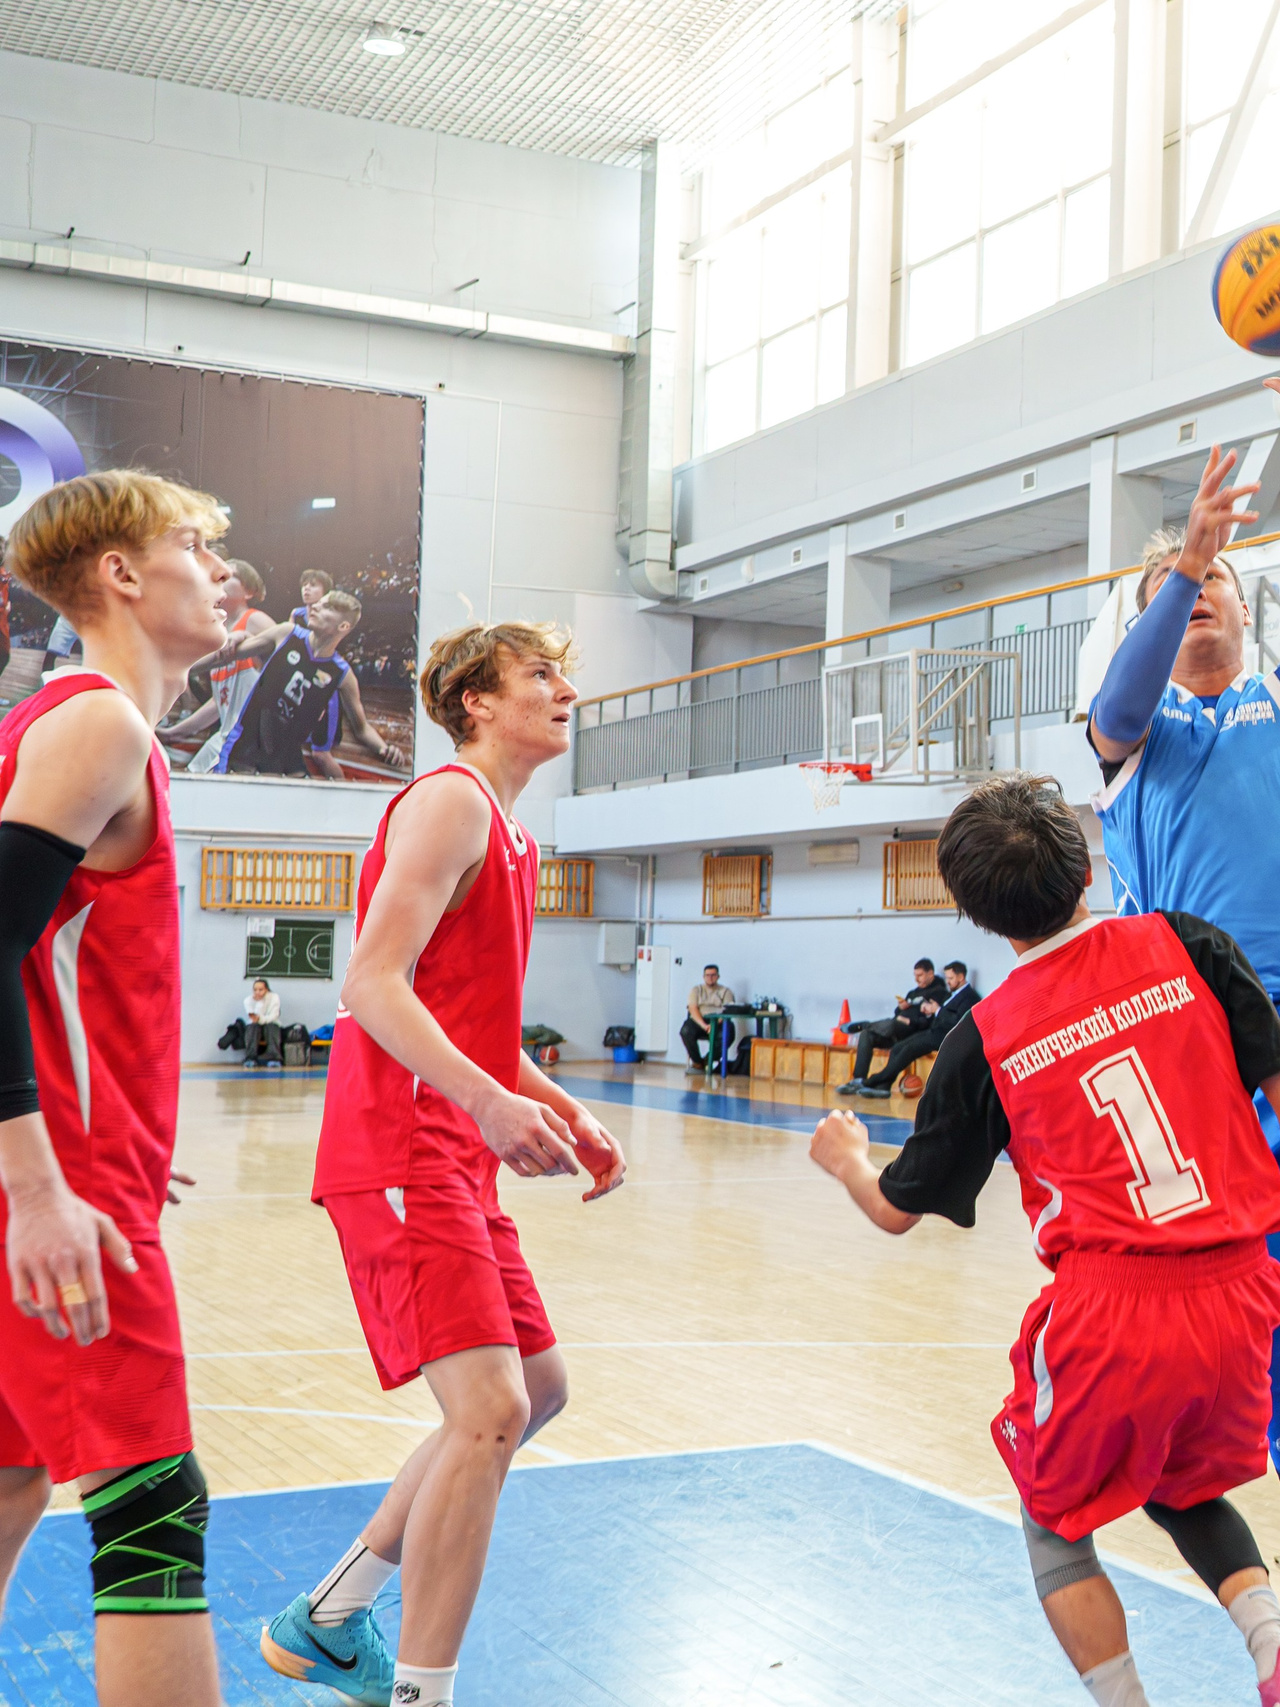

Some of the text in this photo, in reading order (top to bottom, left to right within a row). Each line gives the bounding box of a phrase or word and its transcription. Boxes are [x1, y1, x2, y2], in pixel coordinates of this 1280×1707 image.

[1161, 706, 1193, 723] oma
[1000, 975, 1195, 1085] ТЕХНИЧЕСКИЙ КОЛЛЕДЖ
[1078, 1045, 1212, 1226] 1
